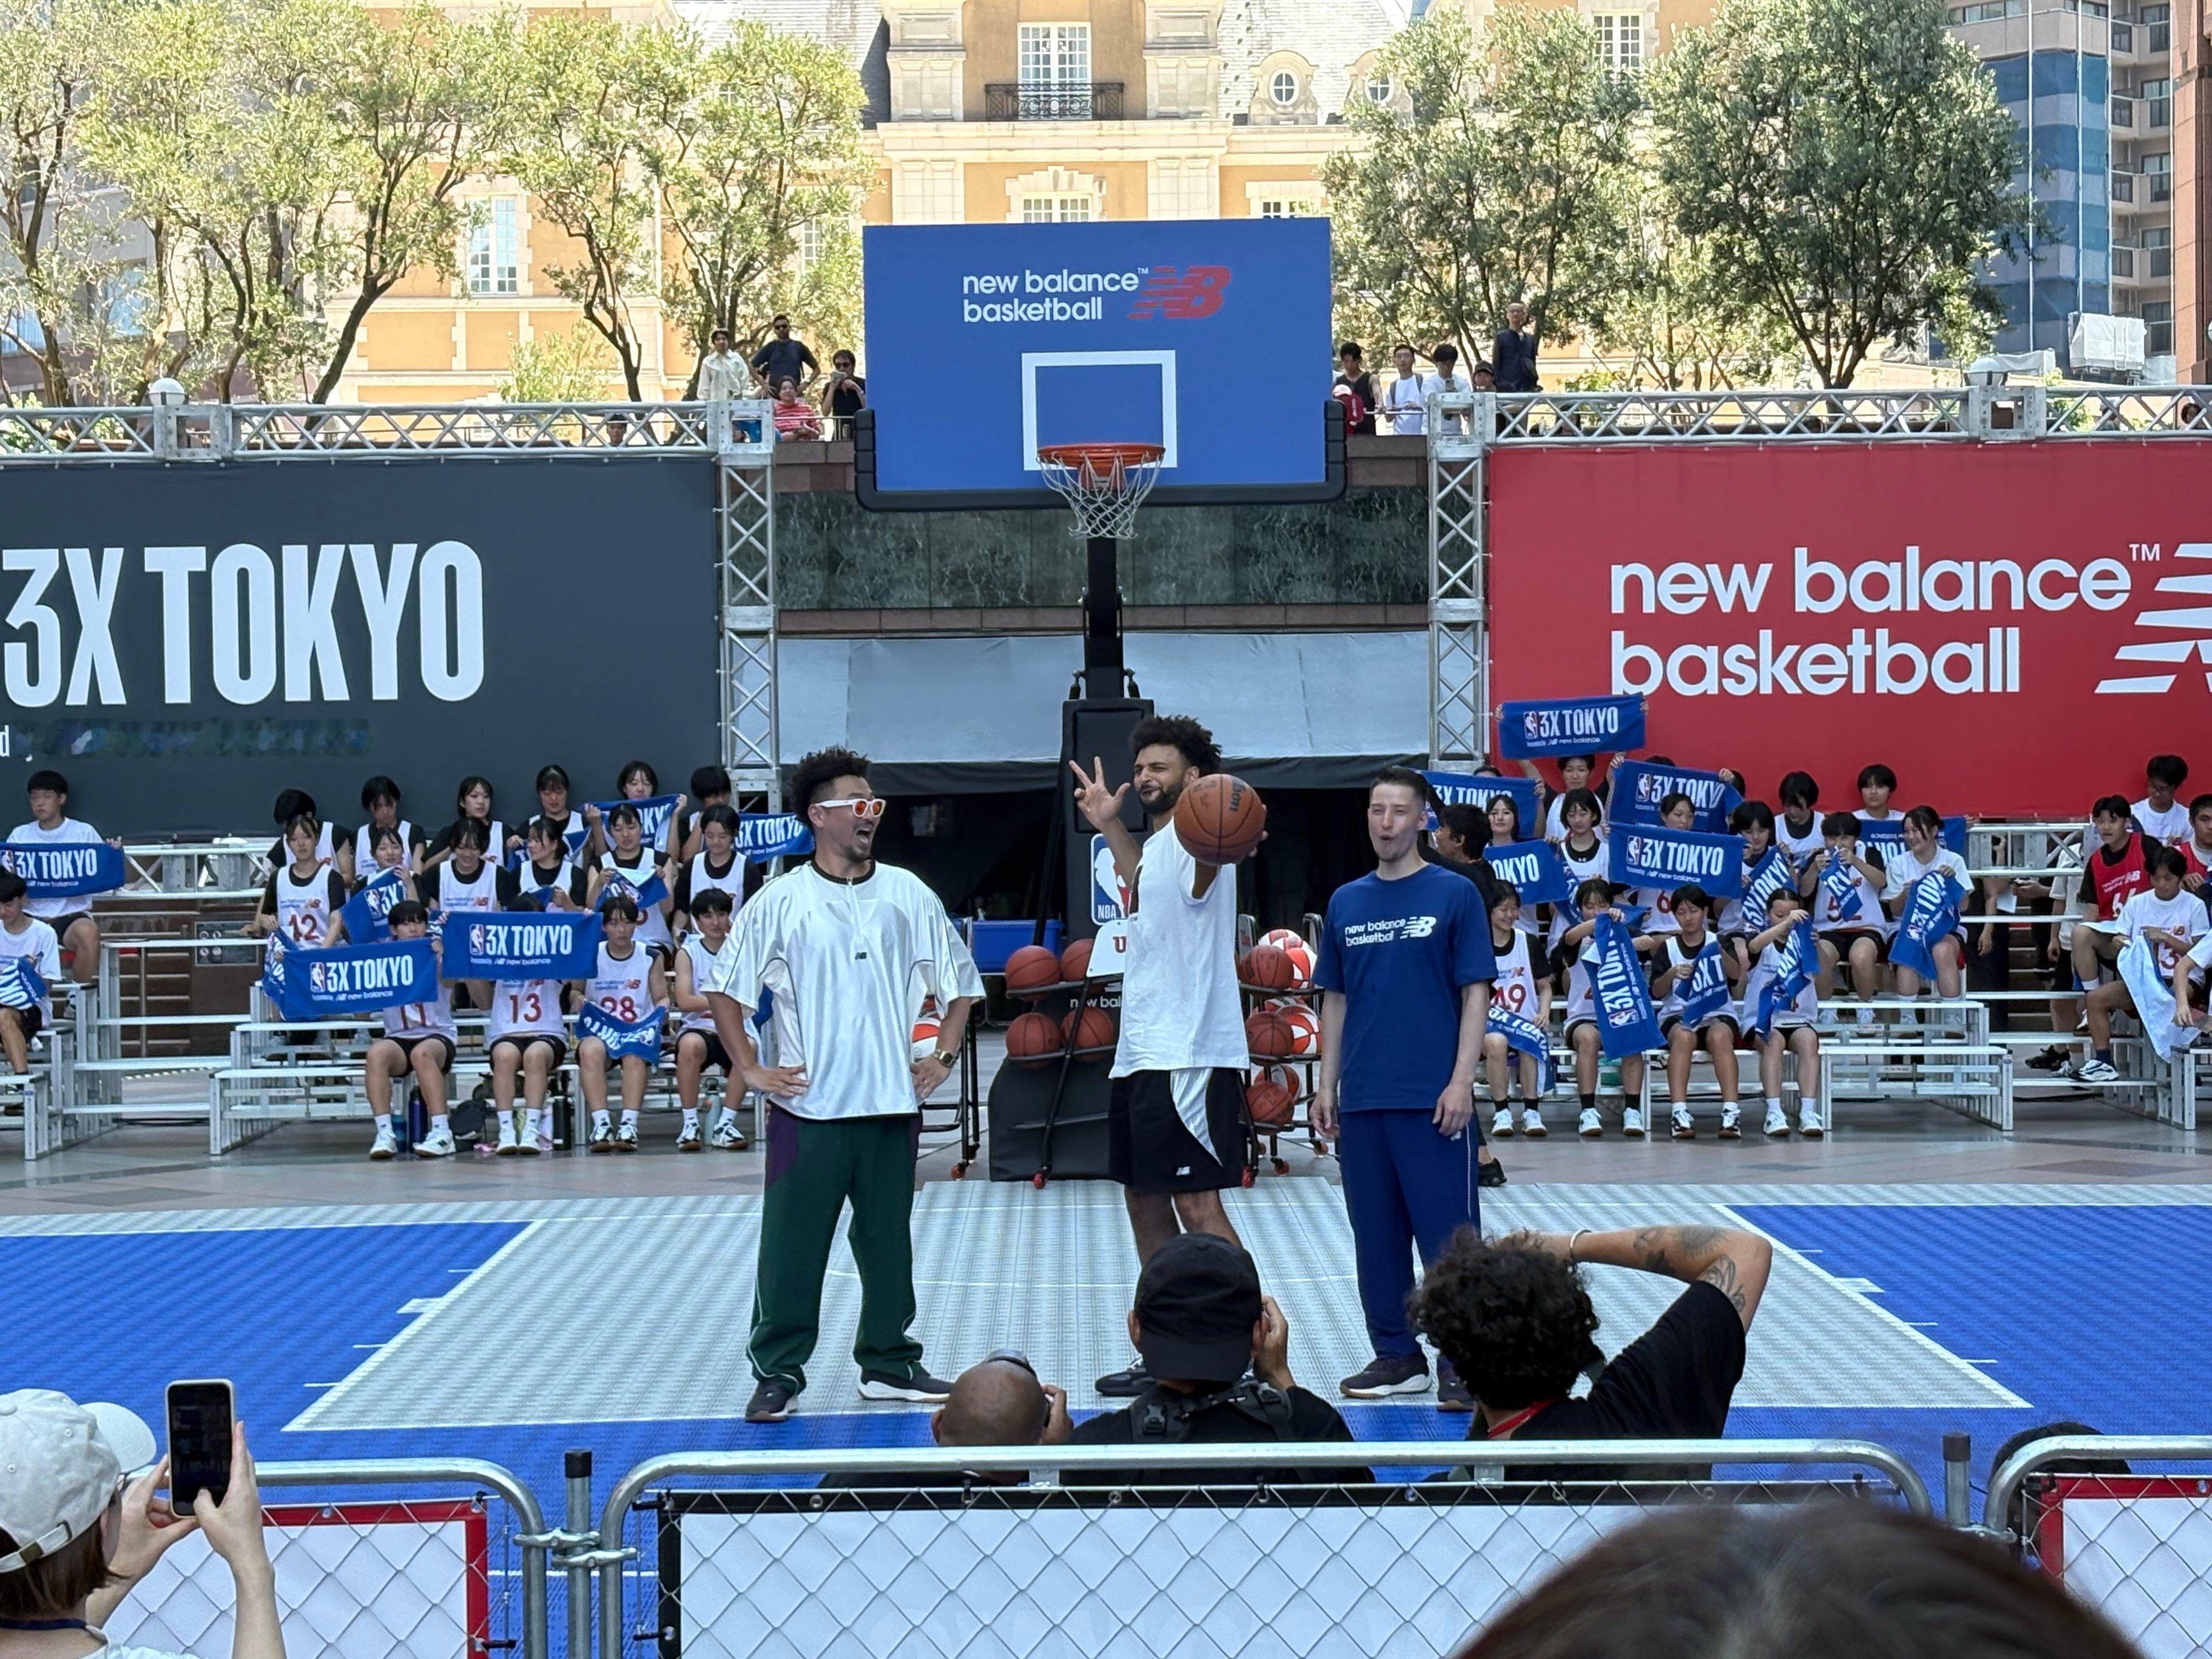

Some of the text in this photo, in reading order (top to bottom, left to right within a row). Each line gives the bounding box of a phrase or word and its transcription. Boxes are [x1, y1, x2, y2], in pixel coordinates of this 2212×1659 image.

[963, 275, 1018, 294] new
[1025, 269, 1139, 294] balance
[964, 297, 1102, 323] basketball
[1611, 562, 1773, 614] new
[1795, 545, 2132, 613] balance
[2, 540, 484, 707] 3X TOKYO
[1611, 627, 2020, 696] basketball
[1538, 706, 1618, 737] 3X TOKYO
[15, 848, 97, 879] 3X TOKYO
[1488, 854, 1539, 885] OKYO
[1640, 838, 1724, 876] 3X TOKYO
[289, 913, 319, 942] 12
[1098, 905, 1116, 919] NBA
[1345, 918, 1406, 935] new balance
[485, 924, 572, 956] 3X TOKYO
[326, 955, 414, 992] 3X TOKYO
[509, 992, 542, 1024] 13
[600, 995, 638, 1023] 28
[1070, 1000, 1098, 1008] nw
